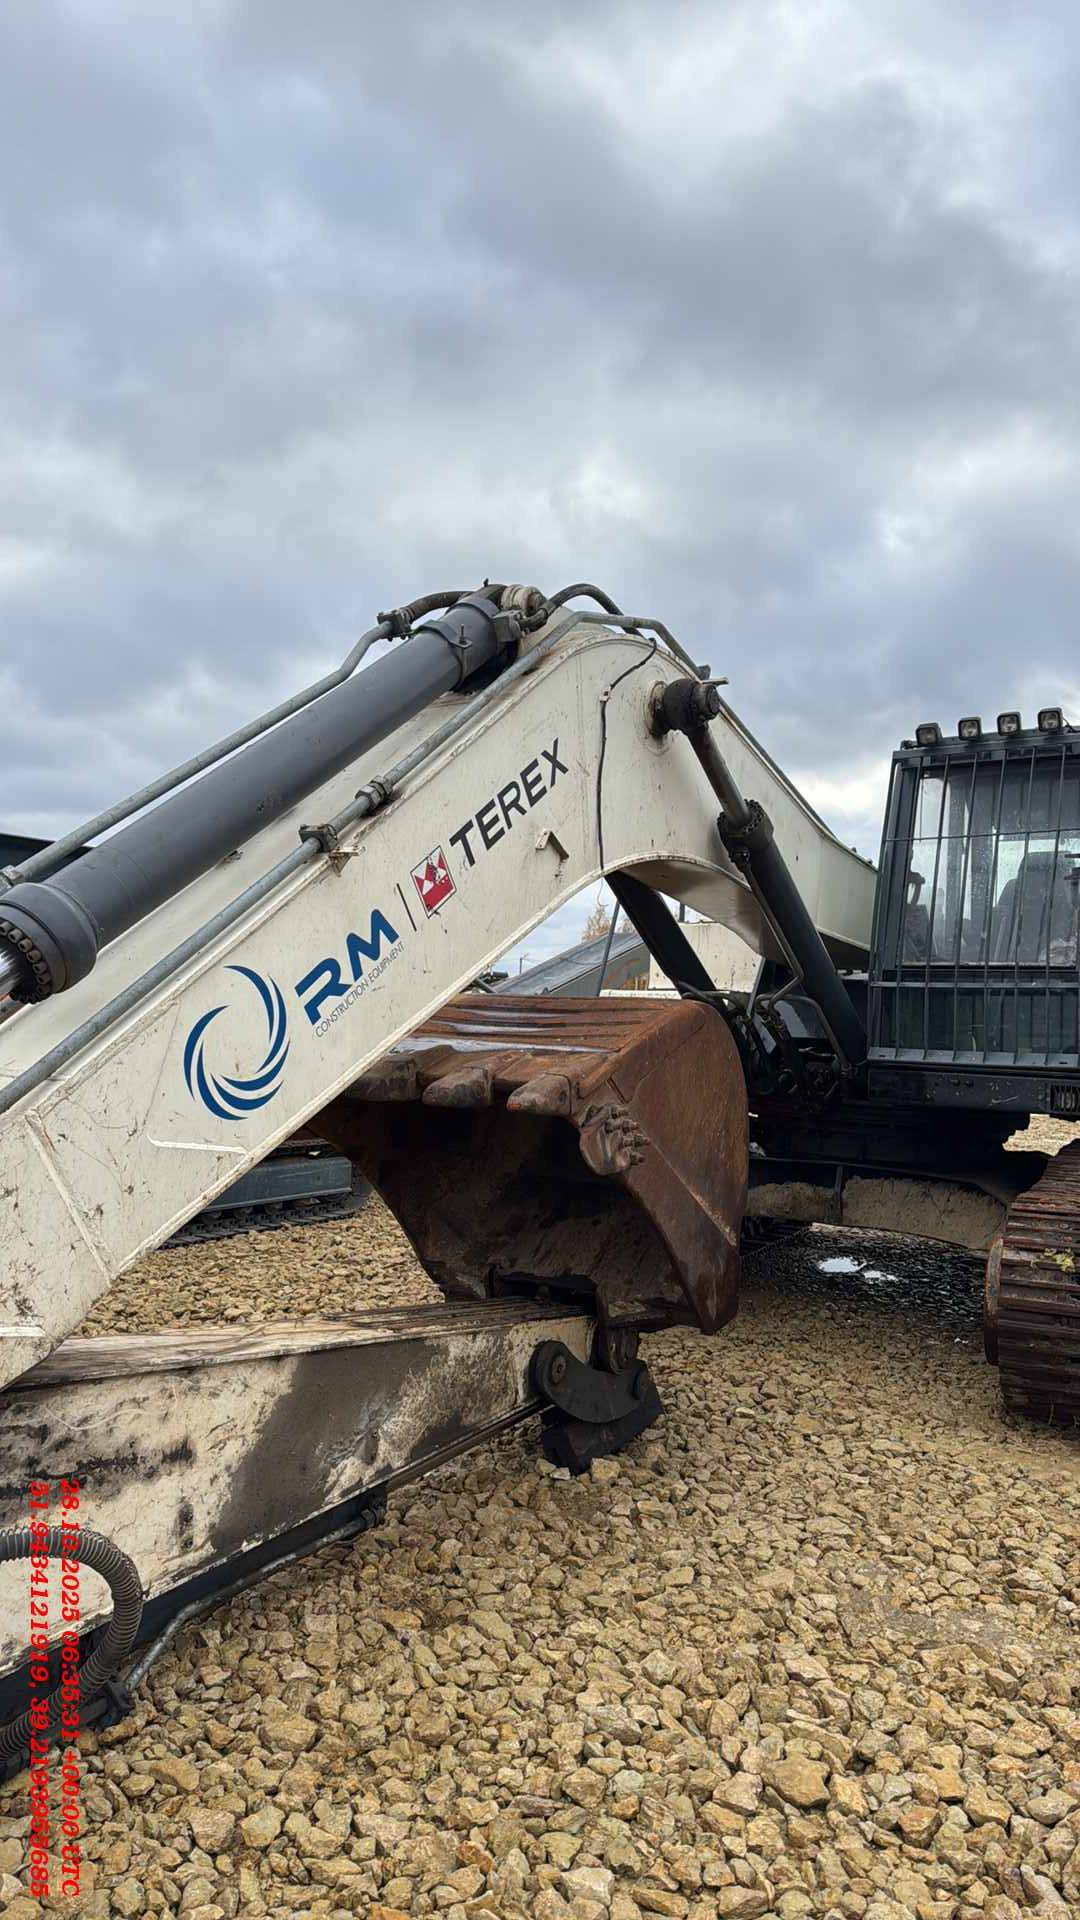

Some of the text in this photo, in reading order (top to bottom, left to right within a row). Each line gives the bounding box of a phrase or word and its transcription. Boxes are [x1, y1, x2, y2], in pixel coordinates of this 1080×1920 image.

[448, 738, 569, 867] TEREX
[294, 908, 400, 1025] RM
[315, 941, 405, 1038] CONSTRUCTION EQUIPMENT
